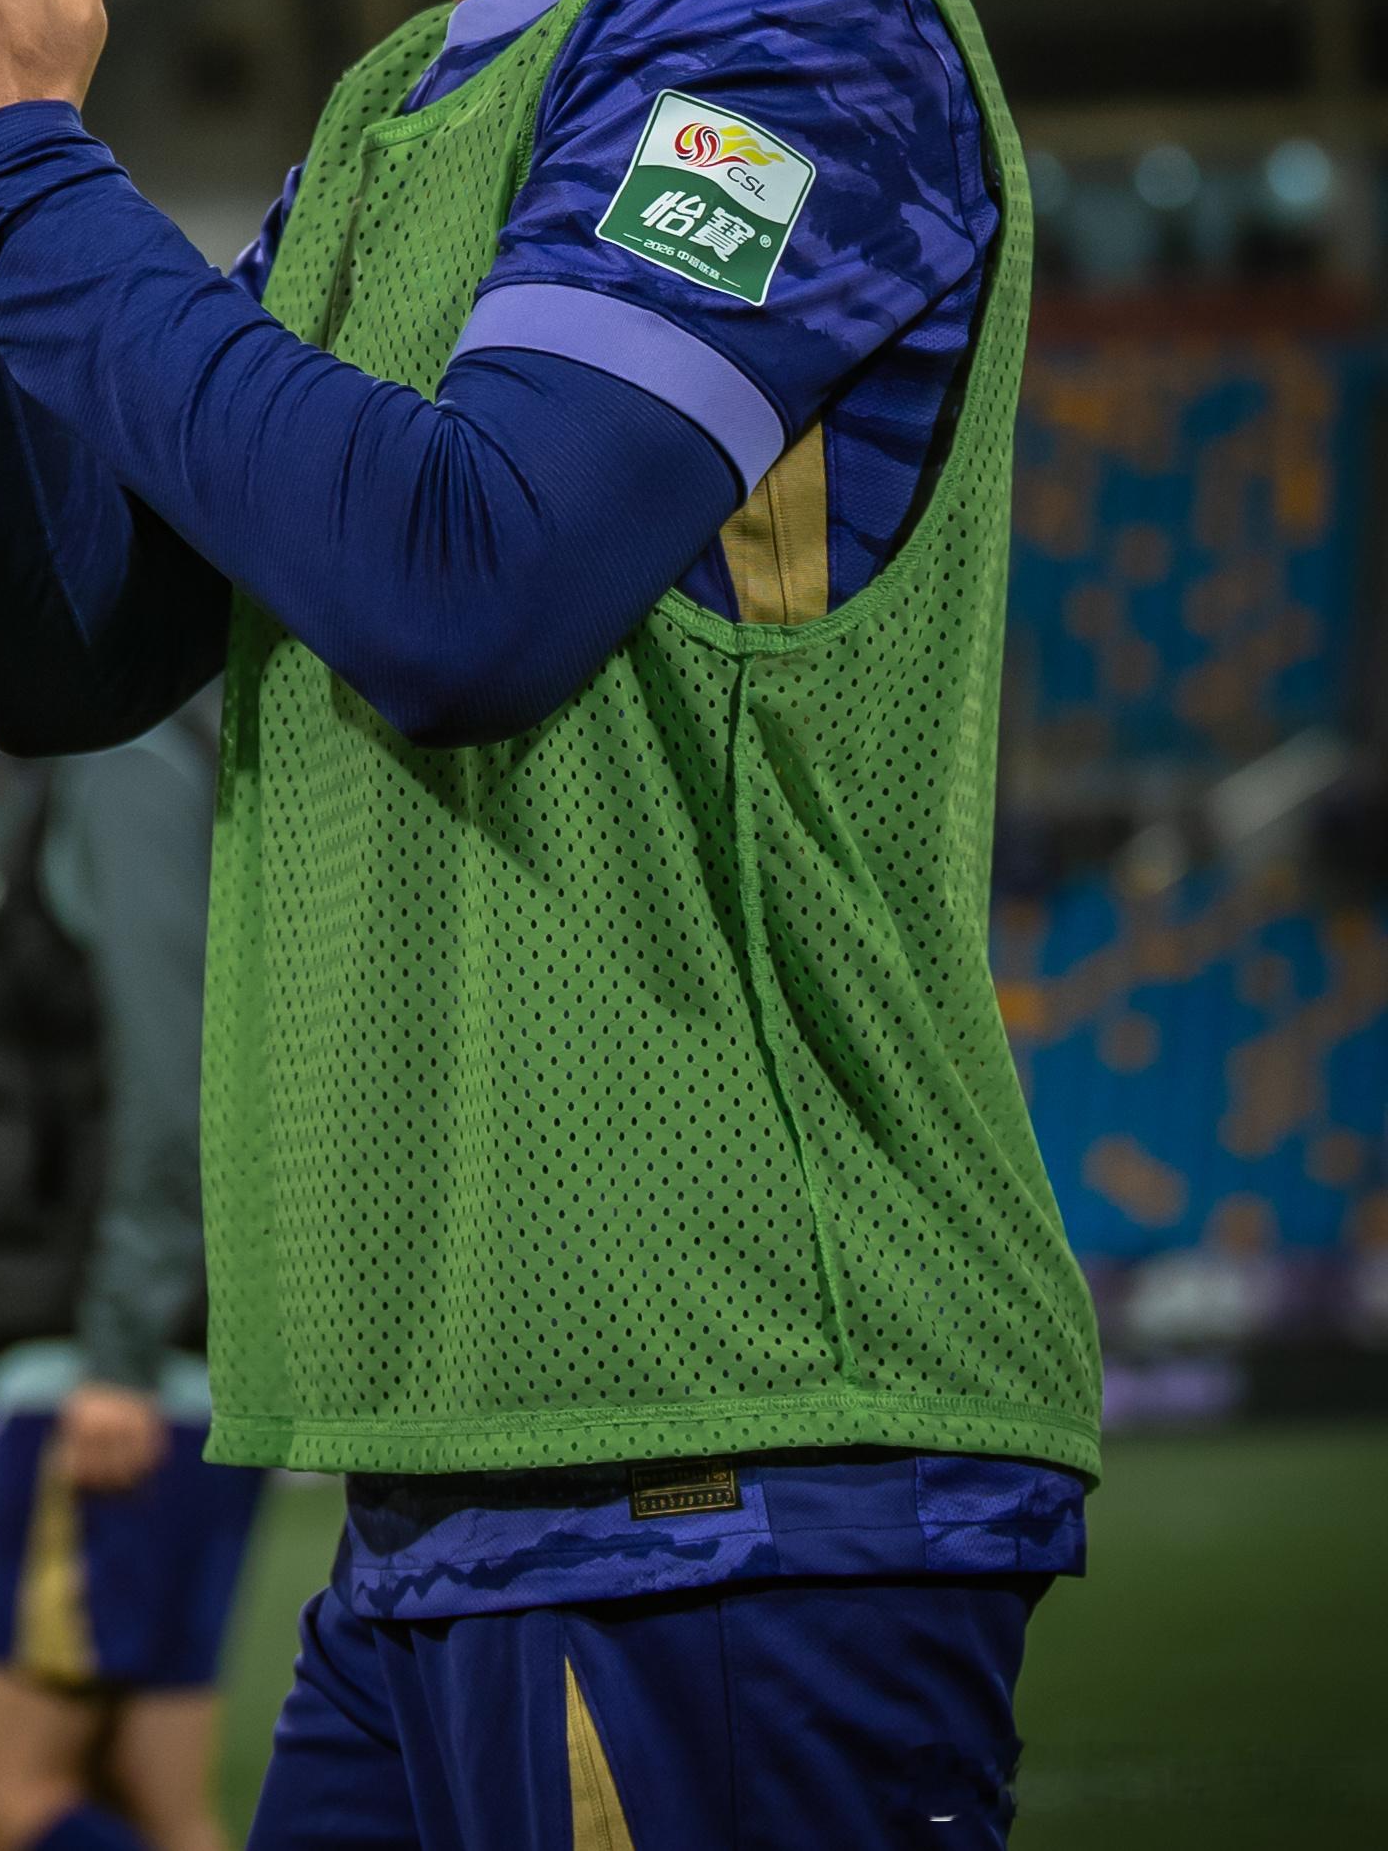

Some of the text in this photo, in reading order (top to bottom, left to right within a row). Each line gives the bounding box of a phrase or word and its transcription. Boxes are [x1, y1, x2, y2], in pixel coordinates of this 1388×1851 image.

[726, 166, 766, 201] CSL
[639, 190, 756, 262] 怡寶
[643, 238, 675, 256] 2026
